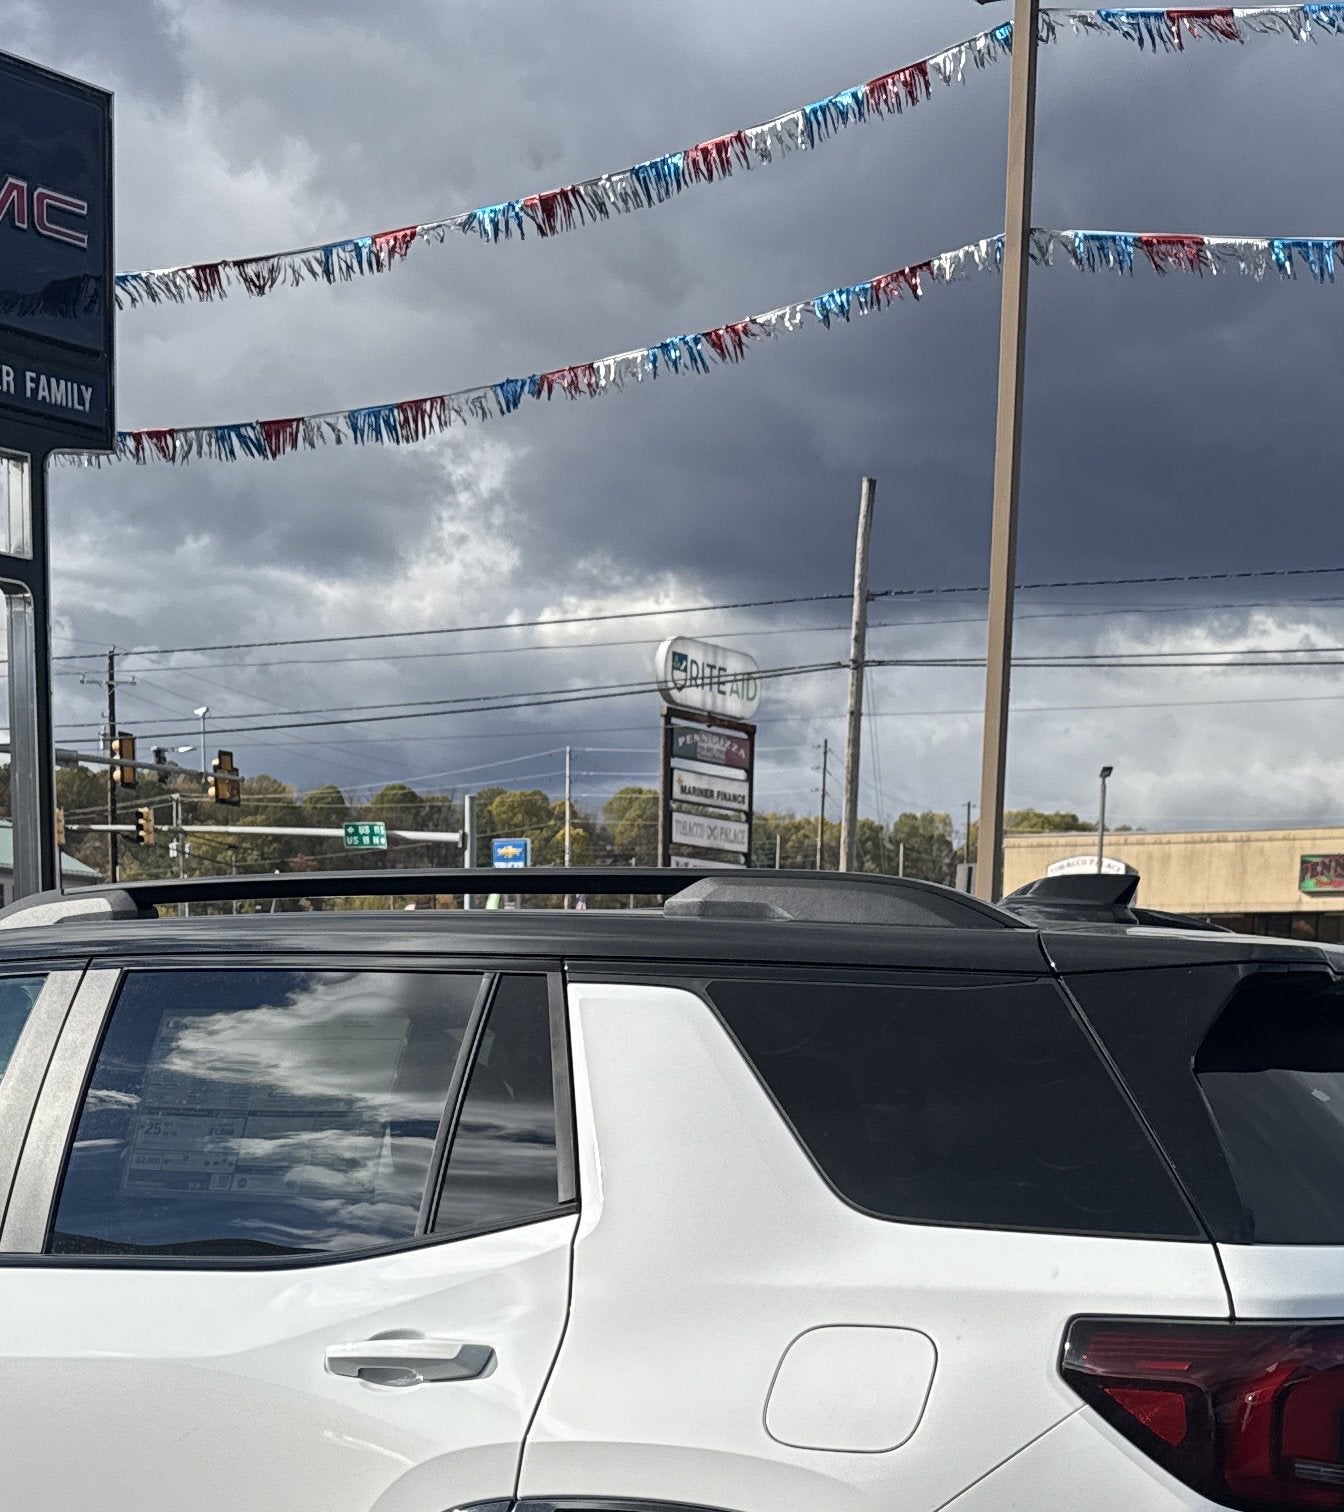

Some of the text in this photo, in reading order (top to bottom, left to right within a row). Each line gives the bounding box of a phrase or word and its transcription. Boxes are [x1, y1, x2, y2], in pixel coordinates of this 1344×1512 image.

[25, 370, 93, 413] FAMILY
[689, 659, 757, 702] RITE AID
[680, 784, 746, 805] MARINER FINANCE
